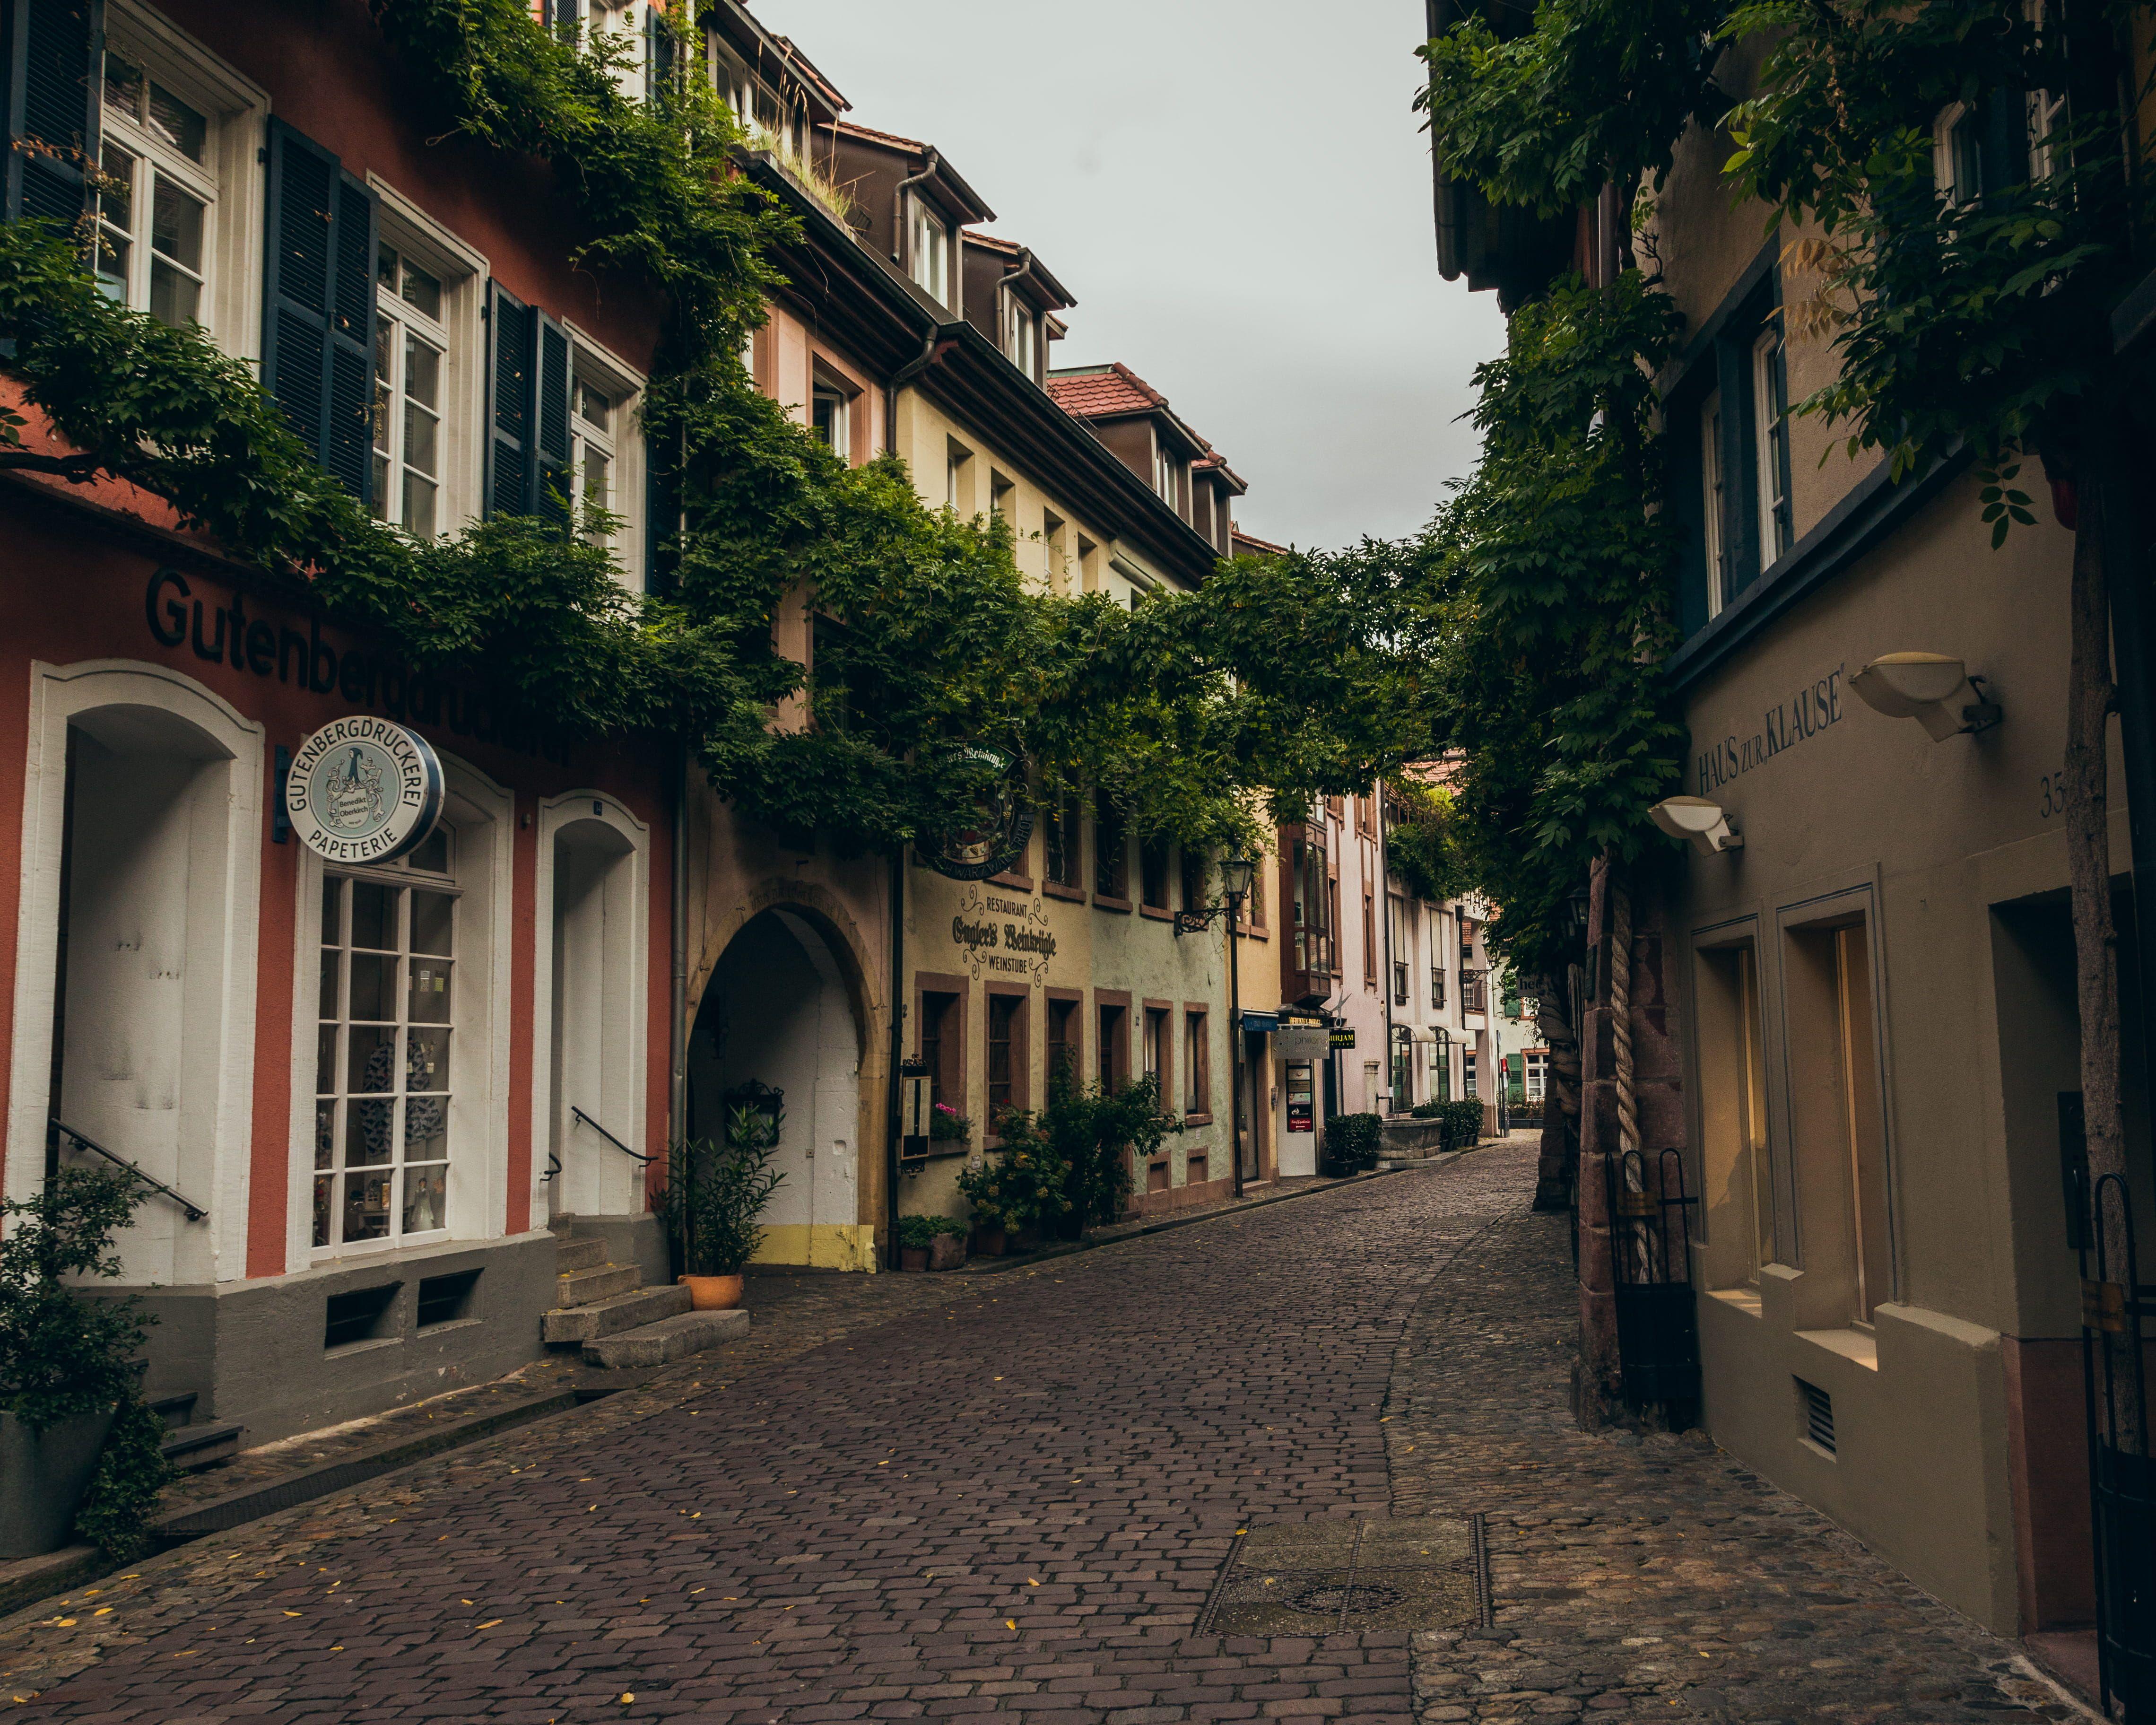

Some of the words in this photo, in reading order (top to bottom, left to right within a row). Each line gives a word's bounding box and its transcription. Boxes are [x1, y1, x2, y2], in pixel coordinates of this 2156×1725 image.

[288, 719, 422, 811] GUTENBERGDRUCKEREI
[1698, 736, 1739, 796] HAUS
[1740, 734, 1763, 773] ZUR
[339, 796, 366, 808] Benedikt
[2041, 771, 2066, 818] 35
[339, 805, 368, 818] Oberkirch
[308, 827, 398, 858] PAPETERIE
[987, 897, 1027, 918] RESTAURANT
[1004, 923, 1057, 961] Weinkrügle
[989, 955, 1027, 974] WEINSTUBE
[1295, 1036, 1328, 1046] philoro
